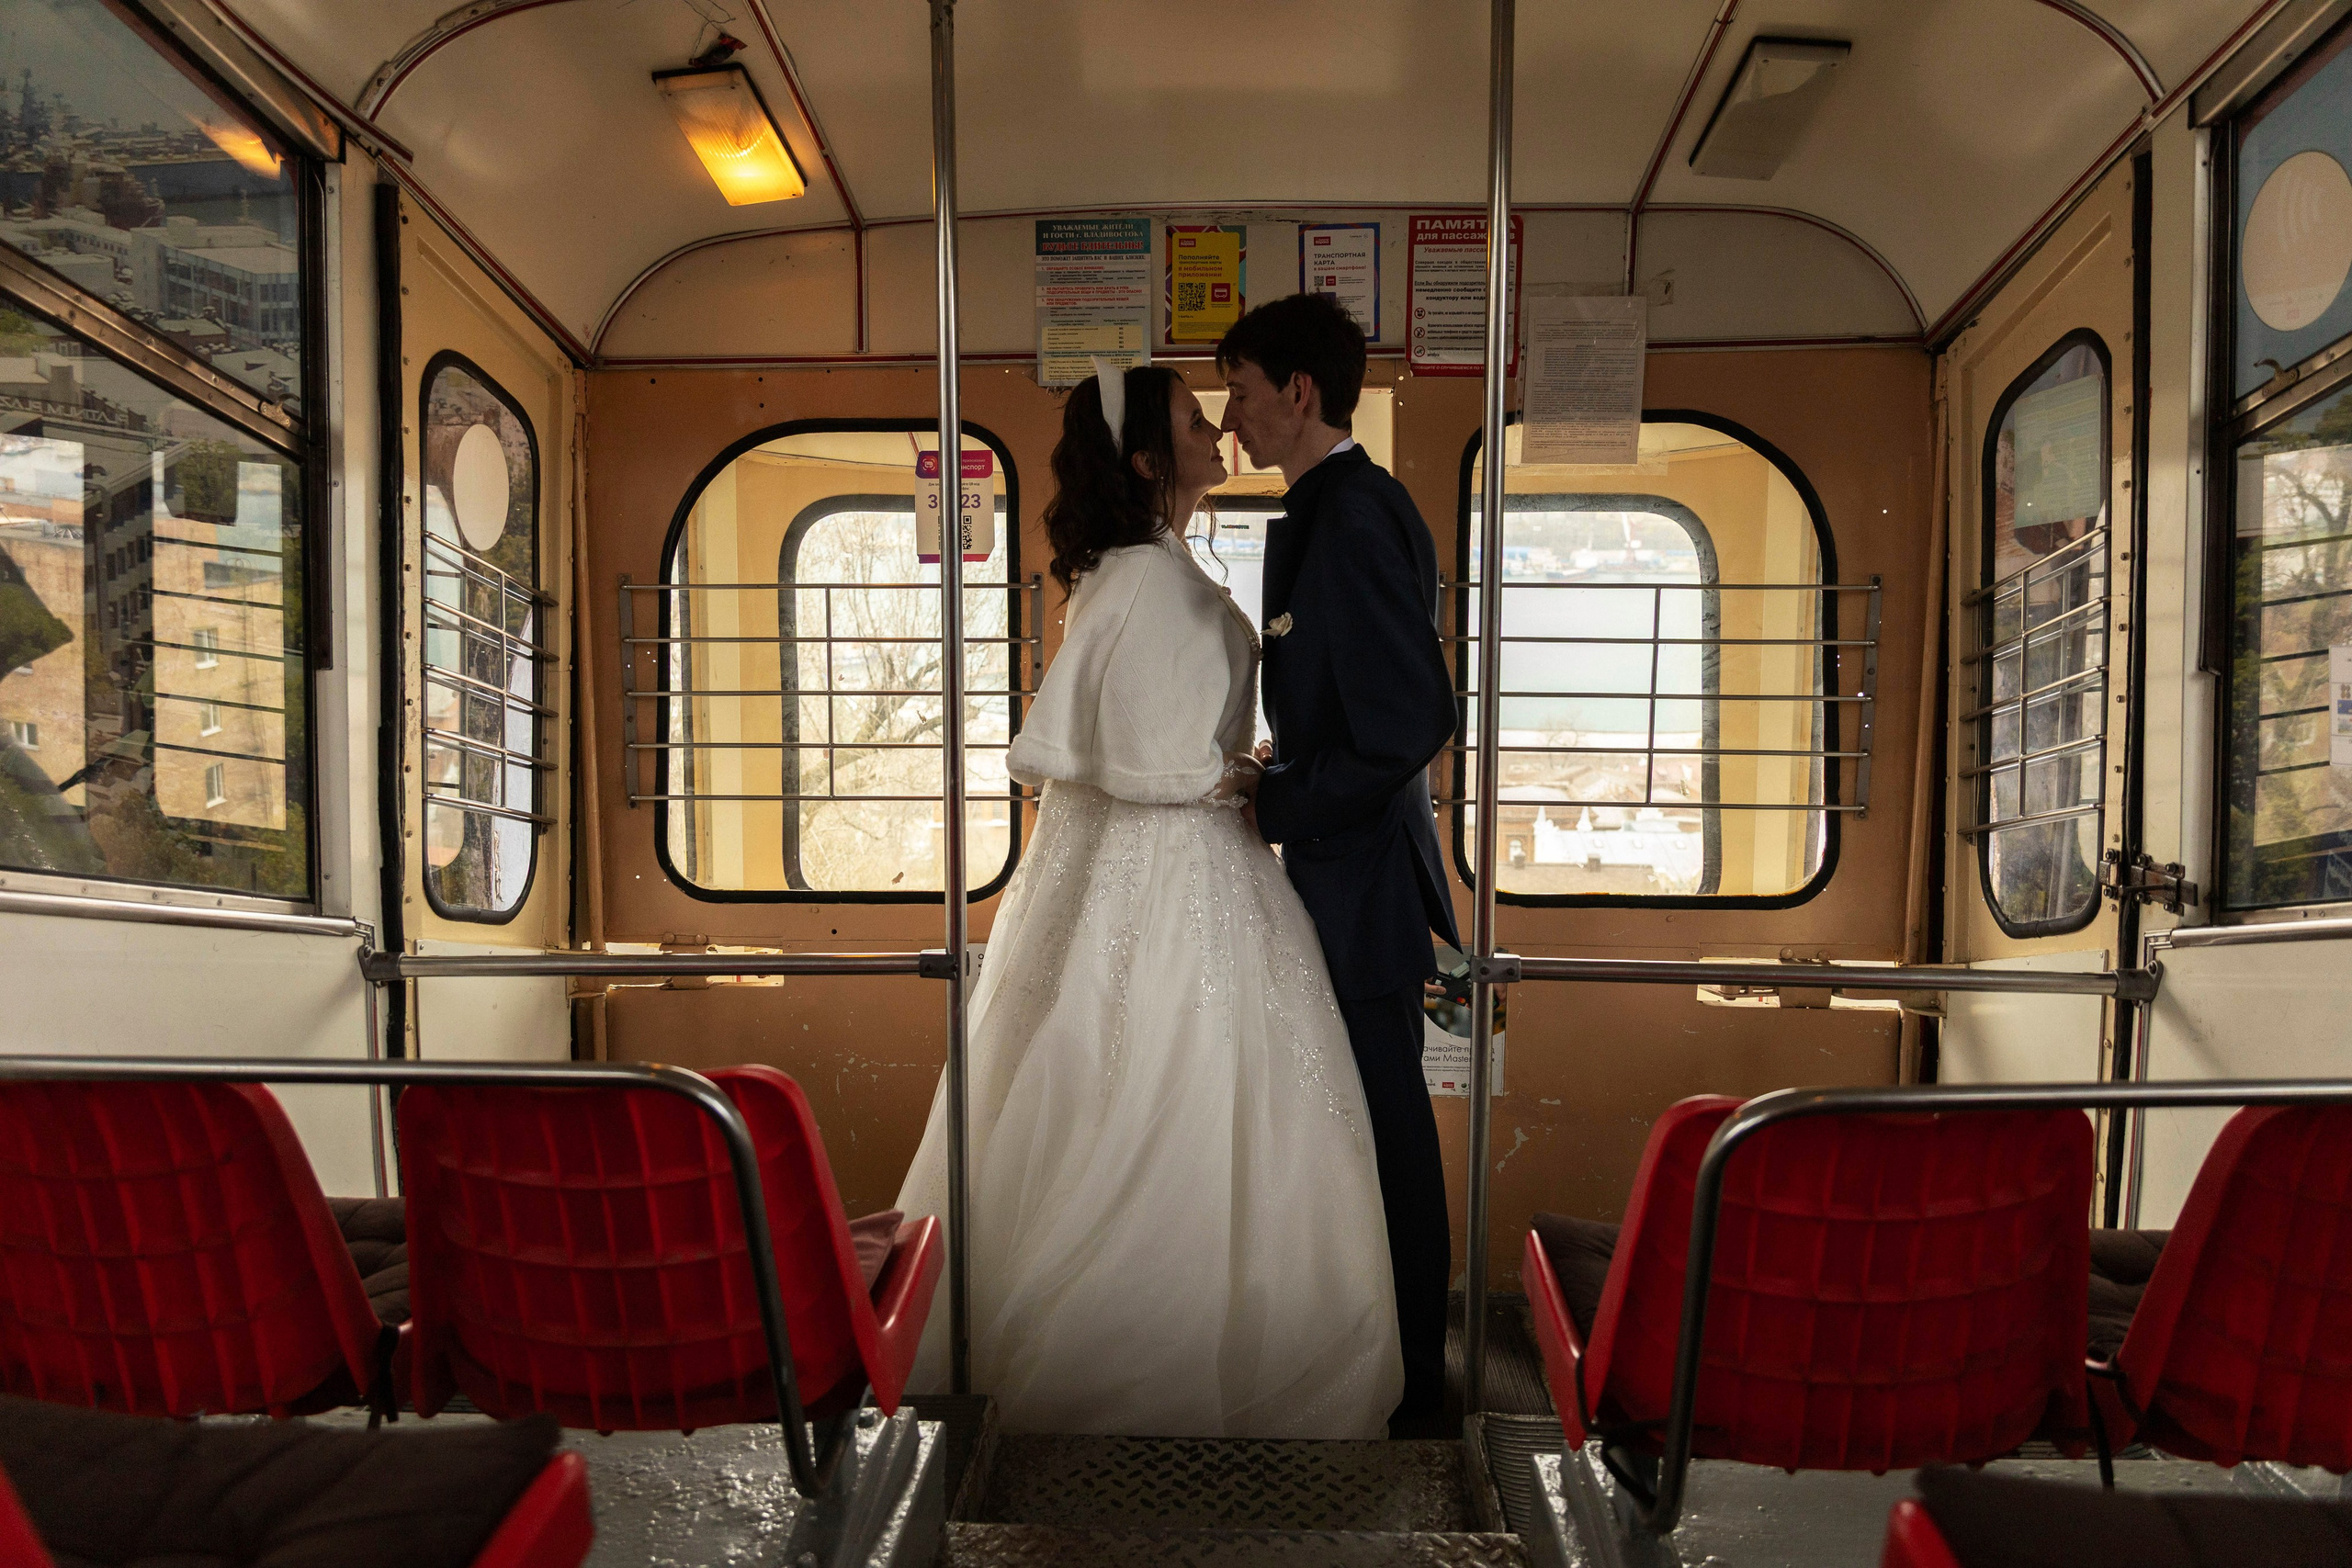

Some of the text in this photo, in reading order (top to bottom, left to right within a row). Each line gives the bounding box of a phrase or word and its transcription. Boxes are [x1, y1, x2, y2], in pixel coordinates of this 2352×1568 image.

[1417, 220, 1517, 231] ПАМЯТА
[1417, 232, 1516, 242] для пассажв
[1042, 241, 1144, 253] БУДЬТЕ БДИТЕЛЬНЫ!
